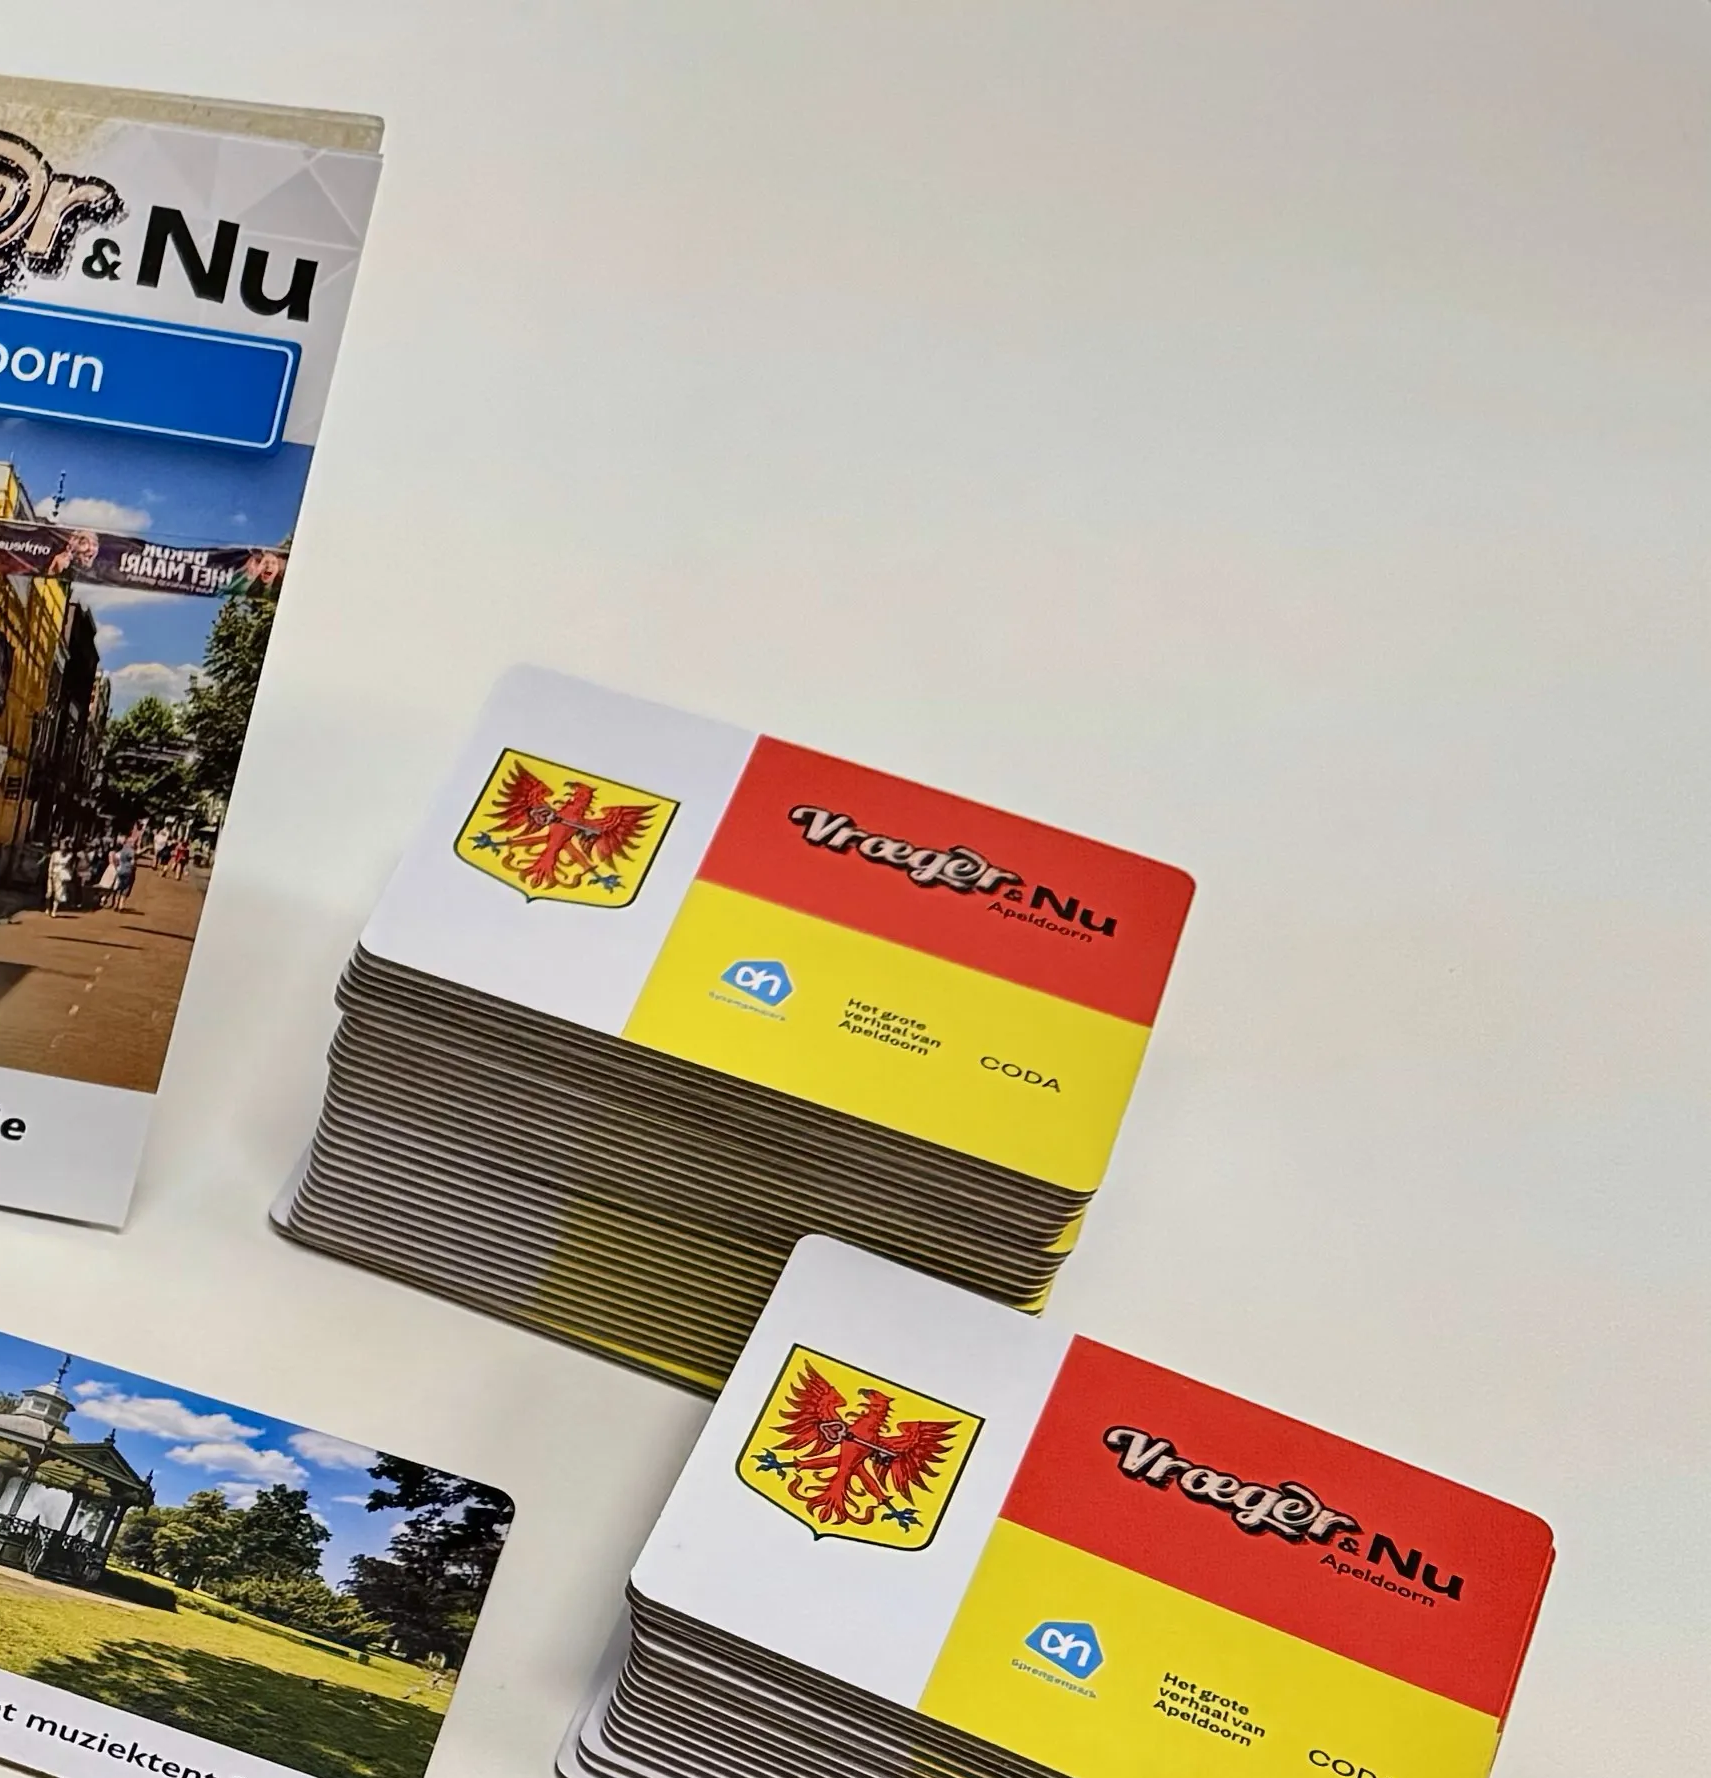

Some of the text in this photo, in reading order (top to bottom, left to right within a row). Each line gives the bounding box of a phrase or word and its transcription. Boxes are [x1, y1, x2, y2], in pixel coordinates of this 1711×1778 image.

[83, 237, 121, 280] &
[136, 206, 320, 322] Nu
[987, 901, 1093, 943] Apeldoorn
[1030, 886, 1118, 938] Nu
[838, 1020, 928, 1056] Apeldoorn
[844, 1010, 941, 1049] verhaal van
[848, 998, 927, 1032] Het grote
[979, 1056, 1062, 1093] CODA
[1320, 1553, 1435, 1608] Apeldoorn
[1337, 1536, 1361, 1557] &
[1366, 1532, 1465, 1601] Nu
[1159, 1686, 1266, 1738] verhaal van
[1162, 1672, 1250, 1715] Het grote
[1153, 1698, 1252, 1747] Apeldoorn
